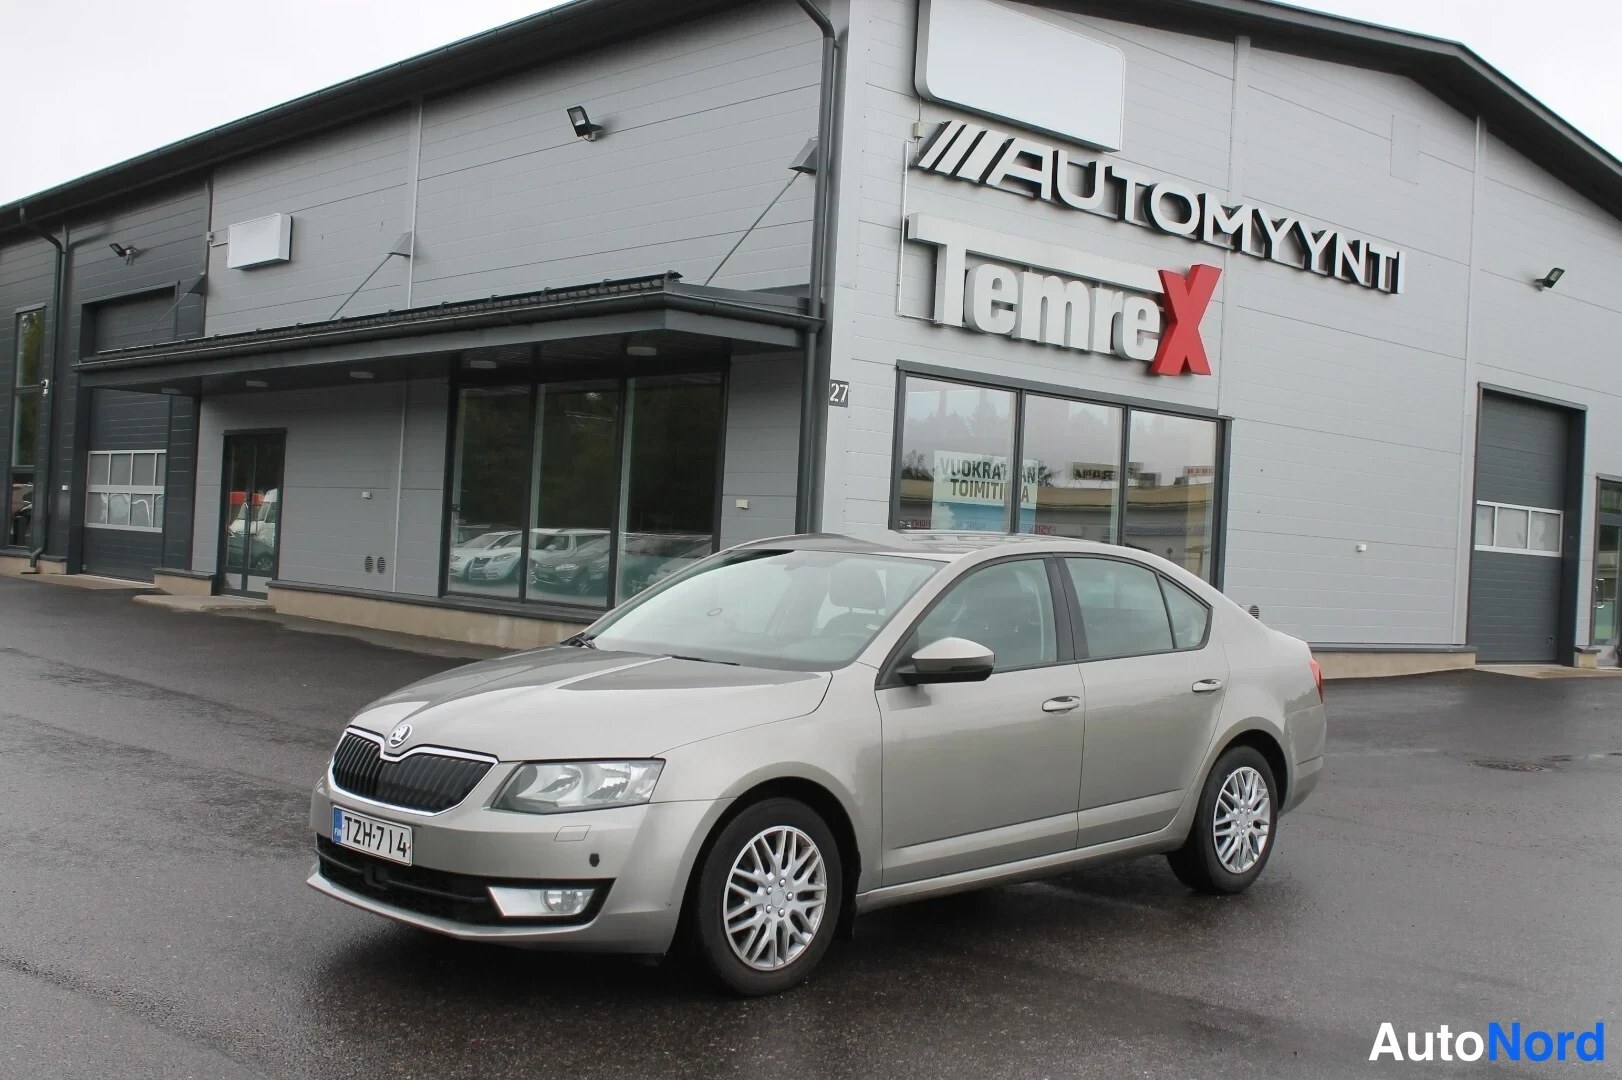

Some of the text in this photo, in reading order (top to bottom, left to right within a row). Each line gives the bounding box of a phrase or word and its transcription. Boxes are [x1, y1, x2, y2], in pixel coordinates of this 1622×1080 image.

[907, 212, 1222, 377] TemreX
[829, 382, 849, 403] 27
[940, 457, 1036, 483] VUOKRATAN
[950, 478, 1030, 503] TOIMITIA
[344, 815, 408, 858] TZH-714
